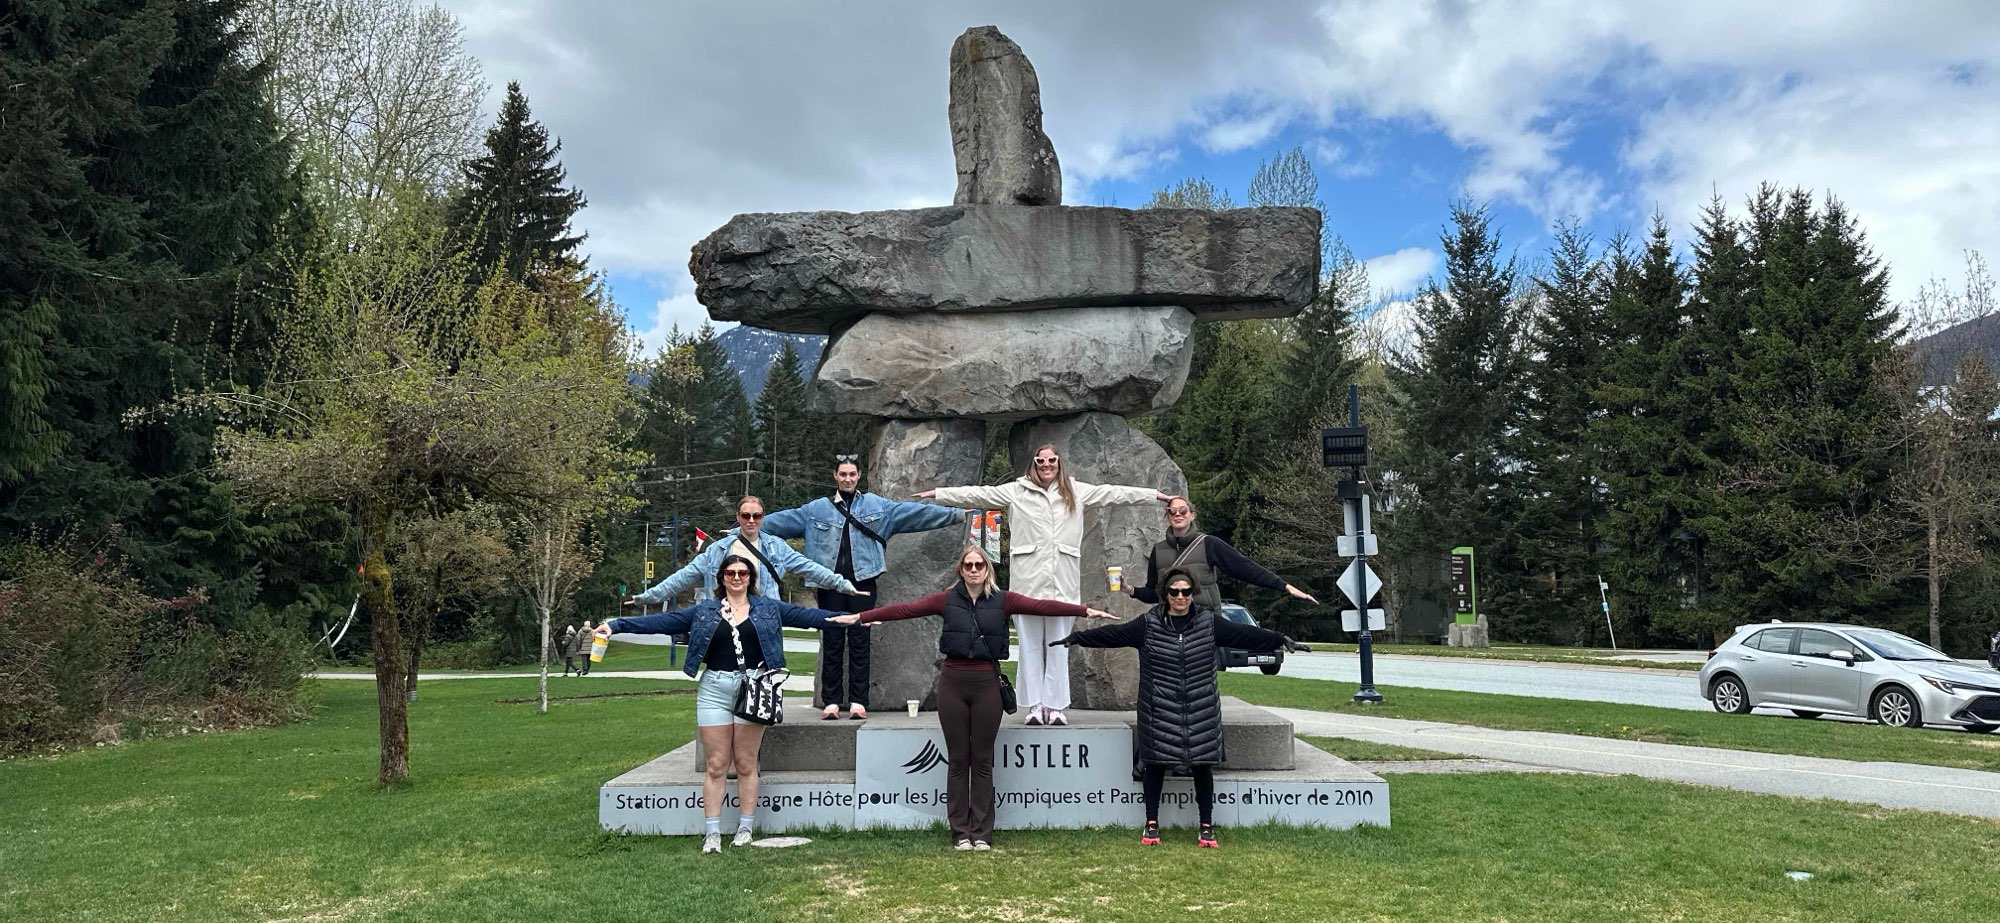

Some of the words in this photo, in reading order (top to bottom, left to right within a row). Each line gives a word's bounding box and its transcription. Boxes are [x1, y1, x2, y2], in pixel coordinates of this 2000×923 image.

[992, 744, 1090, 768] ISTLER
[616, 793, 679, 809] Station
[685, 791, 705, 809] de
[721, 792, 803, 812] Motagne
[809, 790, 853, 807] Hôte
[858, 792, 900, 810] pour
[905, 787, 928, 804] les
[932, 788, 949, 807] Je
[992, 787, 1081, 809] lympiques
[1087, 789, 1105, 804] et
[1111, 788, 1235, 809] Parampies
[1242, 788, 1301, 805] d'hiver
[1307, 788, 1329, 806] de
[1335, 789, 1374, 806] 2010
